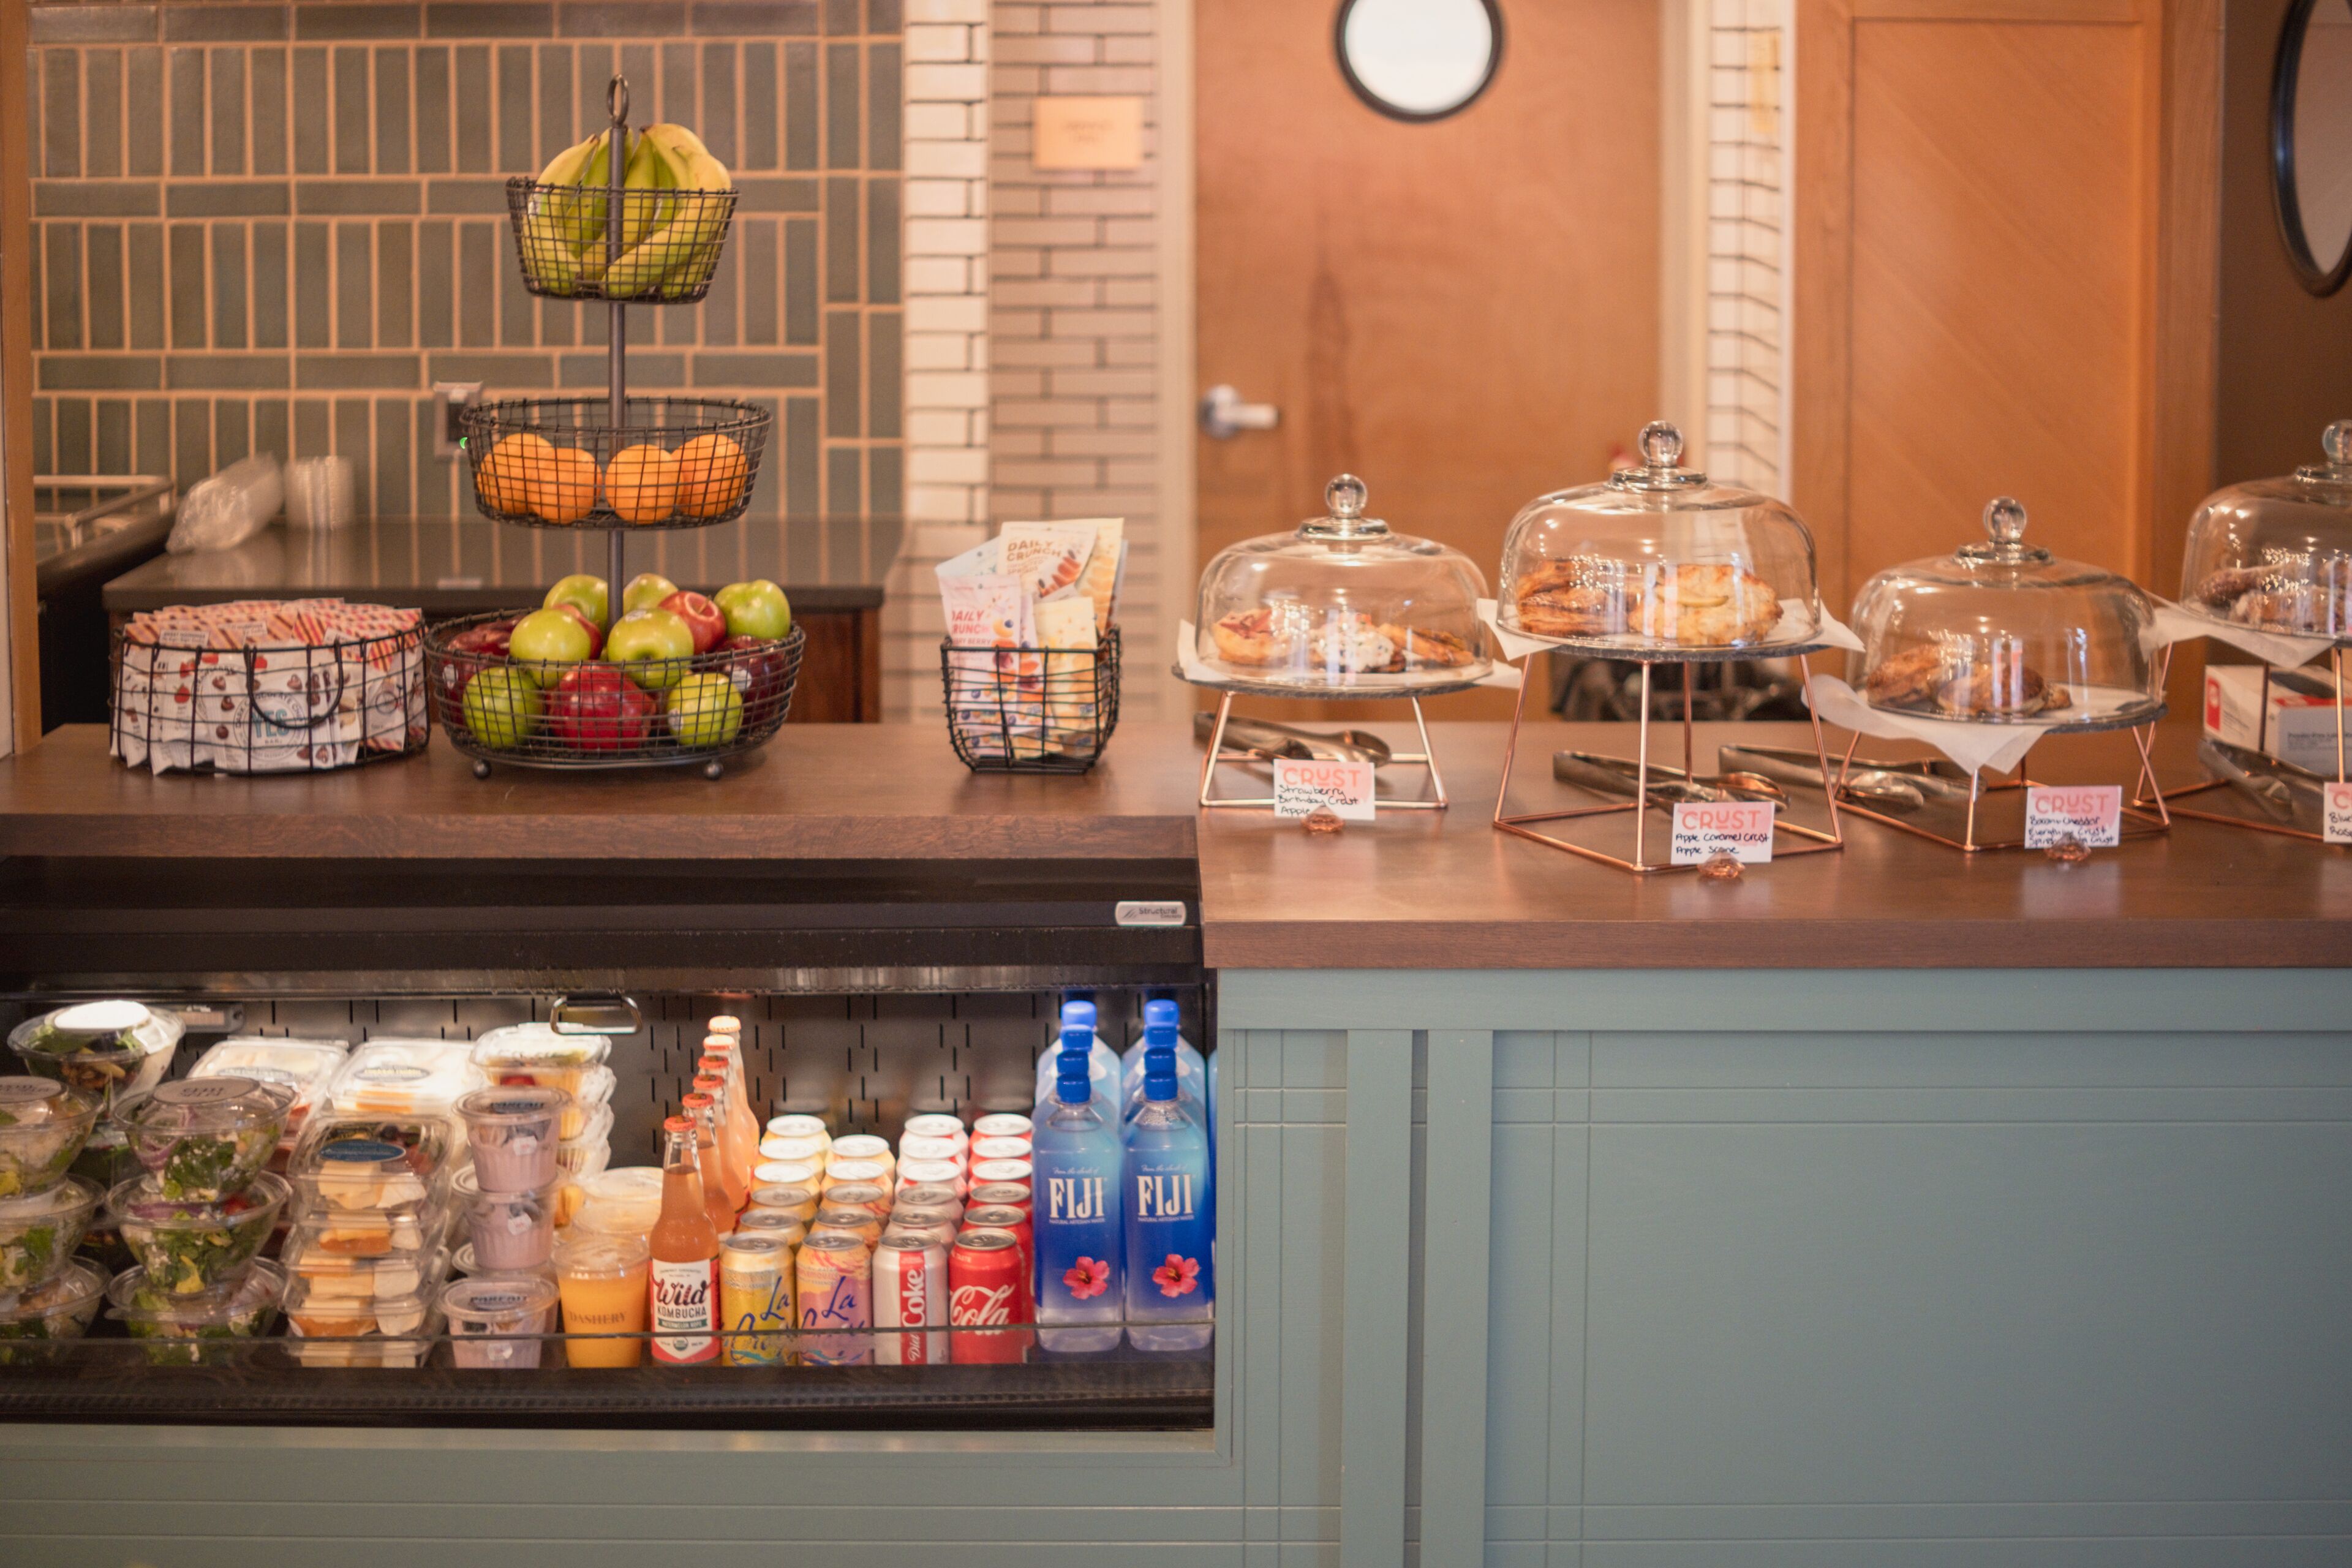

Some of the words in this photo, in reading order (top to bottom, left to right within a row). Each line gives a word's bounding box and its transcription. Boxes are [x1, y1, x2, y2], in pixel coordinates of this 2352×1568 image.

[1007, 548, 1061, 561] CRUNCH
[1008, 540, 1054, 552] DAILY
[252, 709, 288, 738] YES
[1283, 767, 1361, 787] CRUST
[1279, 785, 1345, 796] Strawberry
[2035, 794, 2109, 814] CRUST
[1682, 809, 1761, 830] CRUST
[1675, 833, 1700, 843] Apple
[1703, 832, 1741, 842] Caramel
[1676, 846, 1702, 857] Apple
[1049, 1177, 1105, 1218] FIJI
[1137, 1174, 1194, 1216] FIJI
[654, 1278, 709, 1305] Wild
[760, 1275, 791, 1321] La
[821, 1275, 856, 1321] La
[902, 1268, 925, 1328] Coke
[568, 1311, 628, 1324] DASHERY
[657, 1306, 707, 1318] KOMBUCHA
